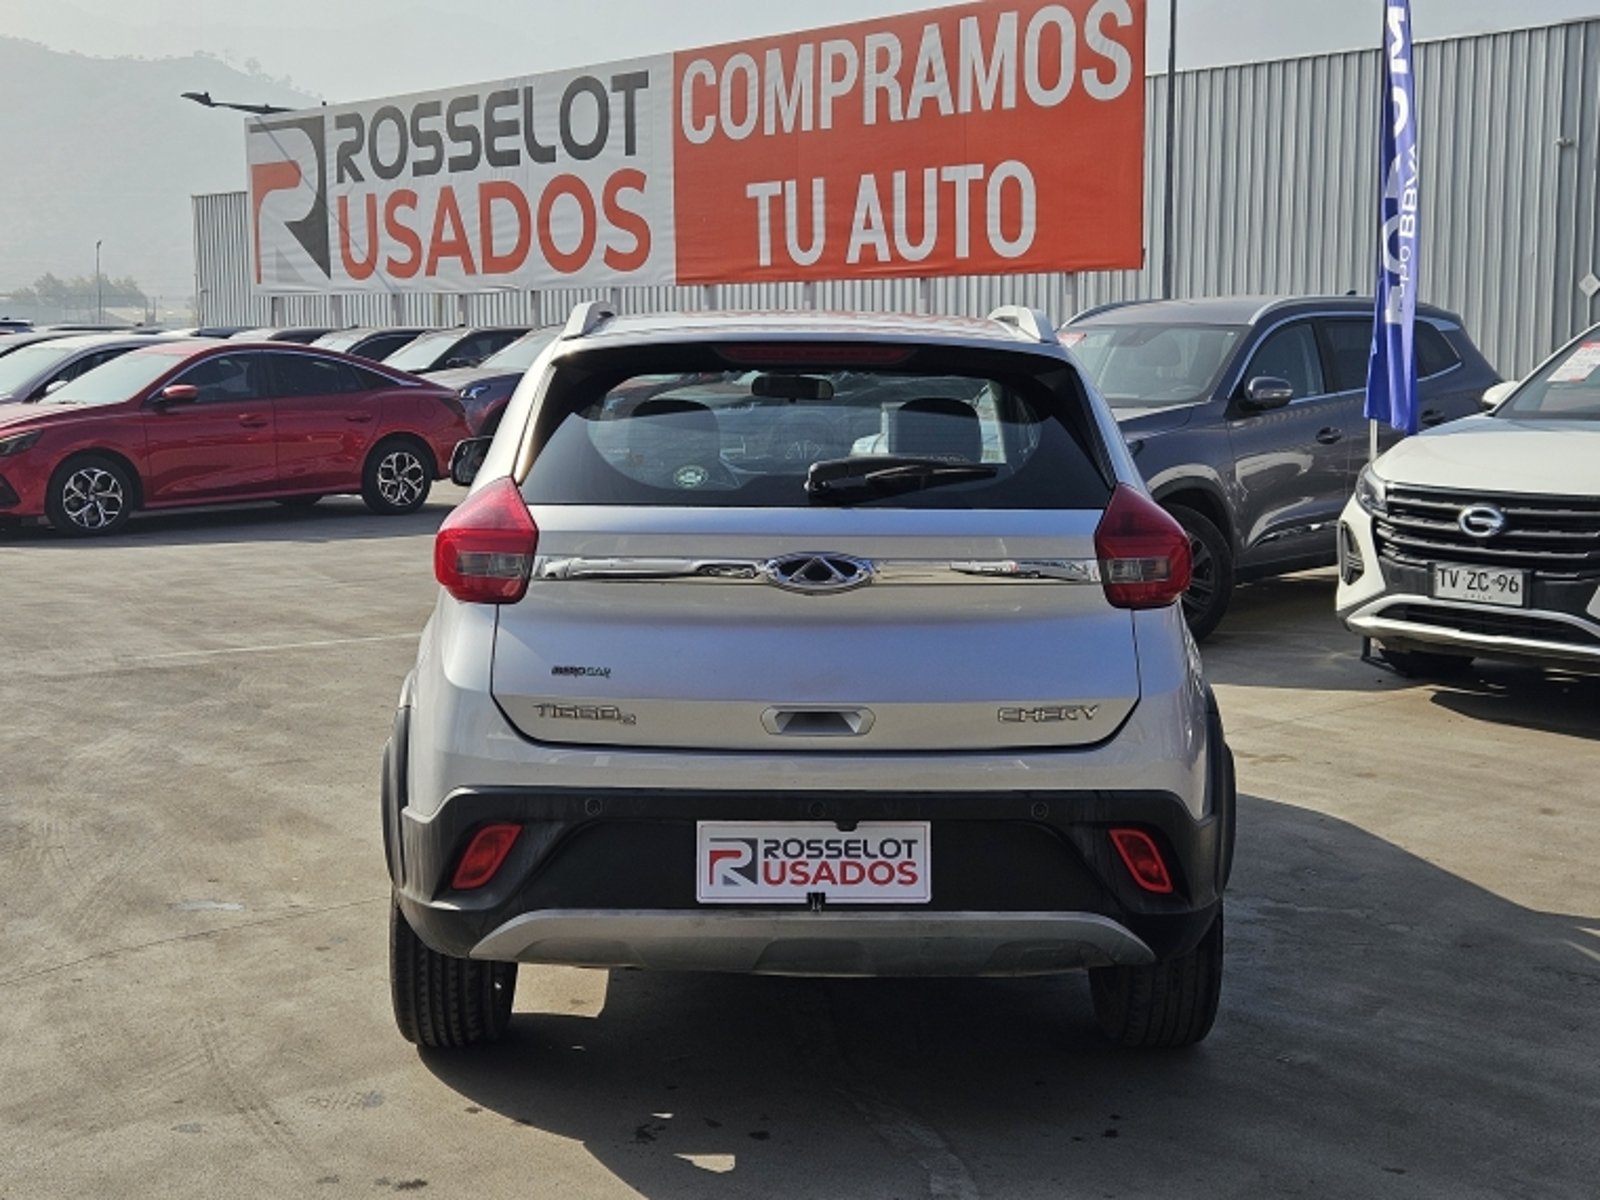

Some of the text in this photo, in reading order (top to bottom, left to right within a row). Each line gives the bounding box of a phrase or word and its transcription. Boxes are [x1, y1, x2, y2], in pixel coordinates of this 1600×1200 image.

[681, 0, 1134, 145] COMPRAMOS
[334, 70, 649, 184] ROSSELOT
[337, 168, 652, 281] USADOS
[746, 159, 1037, 268] TU AUTO
[1437, 568, 1519, 594] TV ZC 96
[998, 704, 1098, 722] CHERY
[762, 860, 919, 886] USADOS
[763, 838, 919, 859] ROSSELOT
